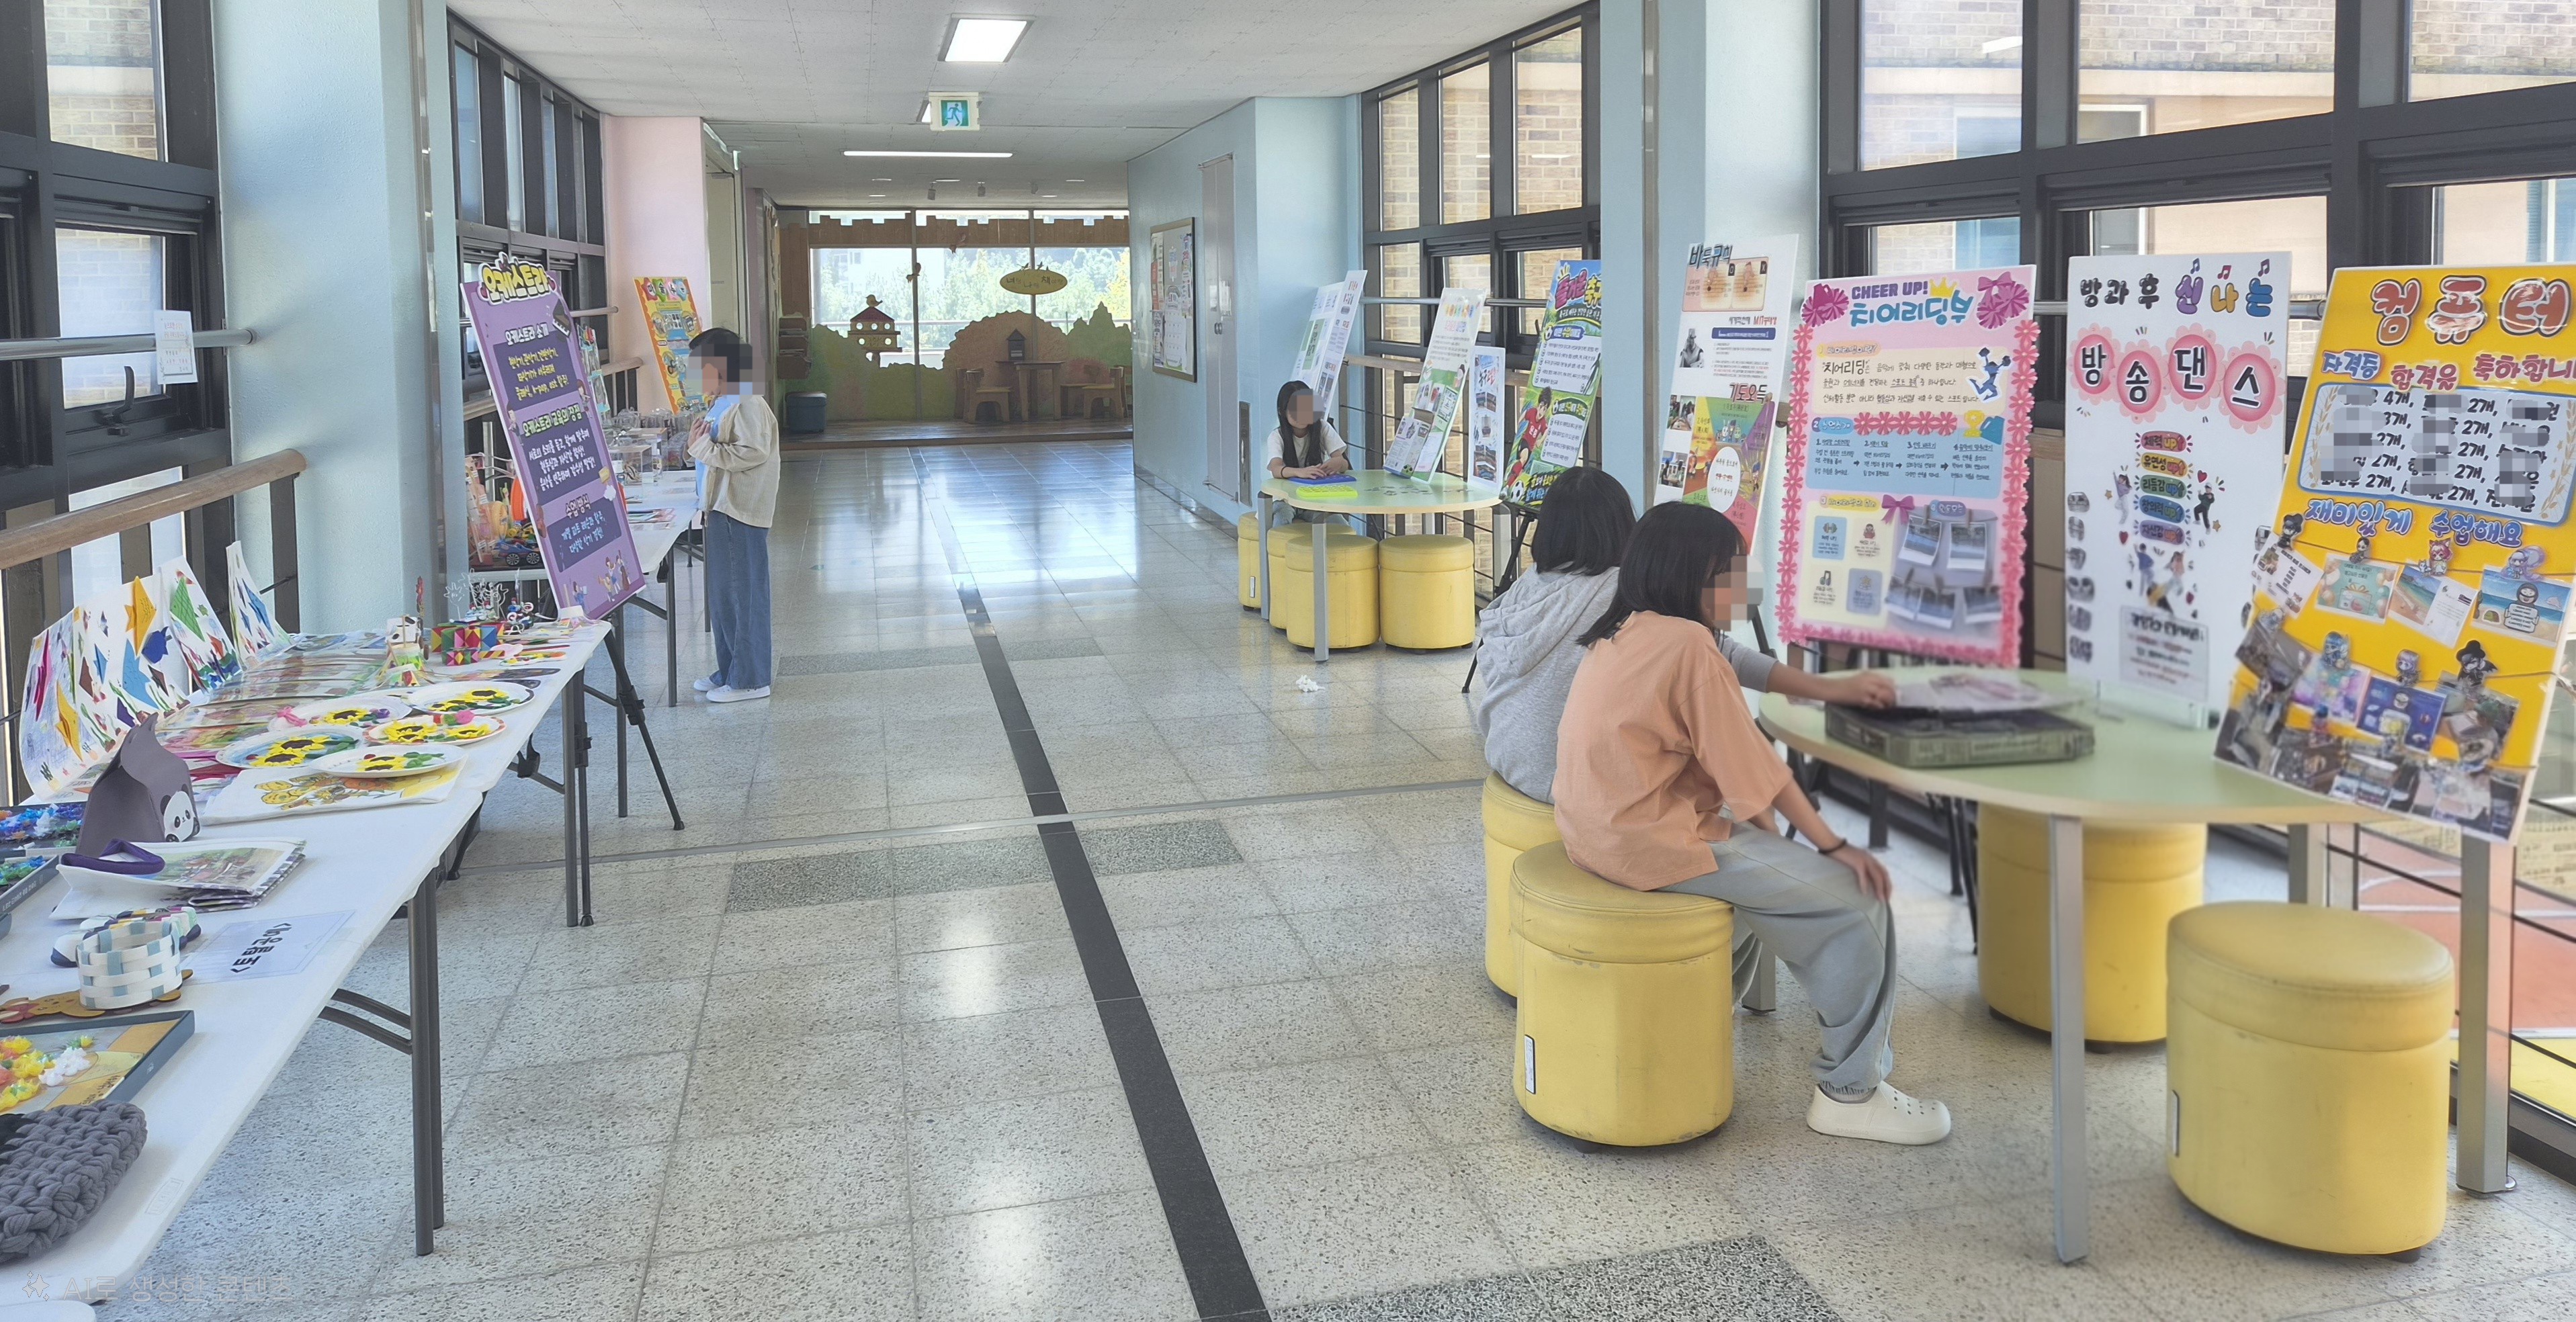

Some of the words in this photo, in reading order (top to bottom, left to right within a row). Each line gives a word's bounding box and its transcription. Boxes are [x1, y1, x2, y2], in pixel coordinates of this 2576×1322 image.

[1689, 244, 1733, 269] 바둑규칙
[482, 264, 550, 302] 오케스트라
[1555, 269, 1587, 310] 즐거운
[1851, 283, 1899, 300] CHEER
[1902, 280, 1928, 296] UP!
[2175, 274, 2273, 317] 신나는
[1850, 290, 1973, 327] 치어리딩부
[2370, 275, 2571, 346] 컴퓨터
[505, 325, 535, 346] 오케스트라
[537, 322, 549, 338] 소개
[2081, 344, 2261, 408] 방송댄스
[2322, 351, 2380, 380] 자격증
[2390, 363, 2458, 391] 합격을
[2473, 353, 2576, 384] 축하합니
[1729, 383, 1768, 404] 기도오득
[523, 414, 552, 437] 오케스트라
[551, 407, 569, 426] 교육의
[568, 402, 583, 422] 장점
[2144, 435, 2162, 449] 체력
[2144, 455, 2167, 471] 유연성
[2143, 478, 2165, 492] 리듬감
[2142, 498, 2163, 515] 창의력
[2142, 524, 2163, 538] 자신감
[2305, 498, 2413, 537] 재미있게
[2430, 509, 2523, 547] 수업해요
